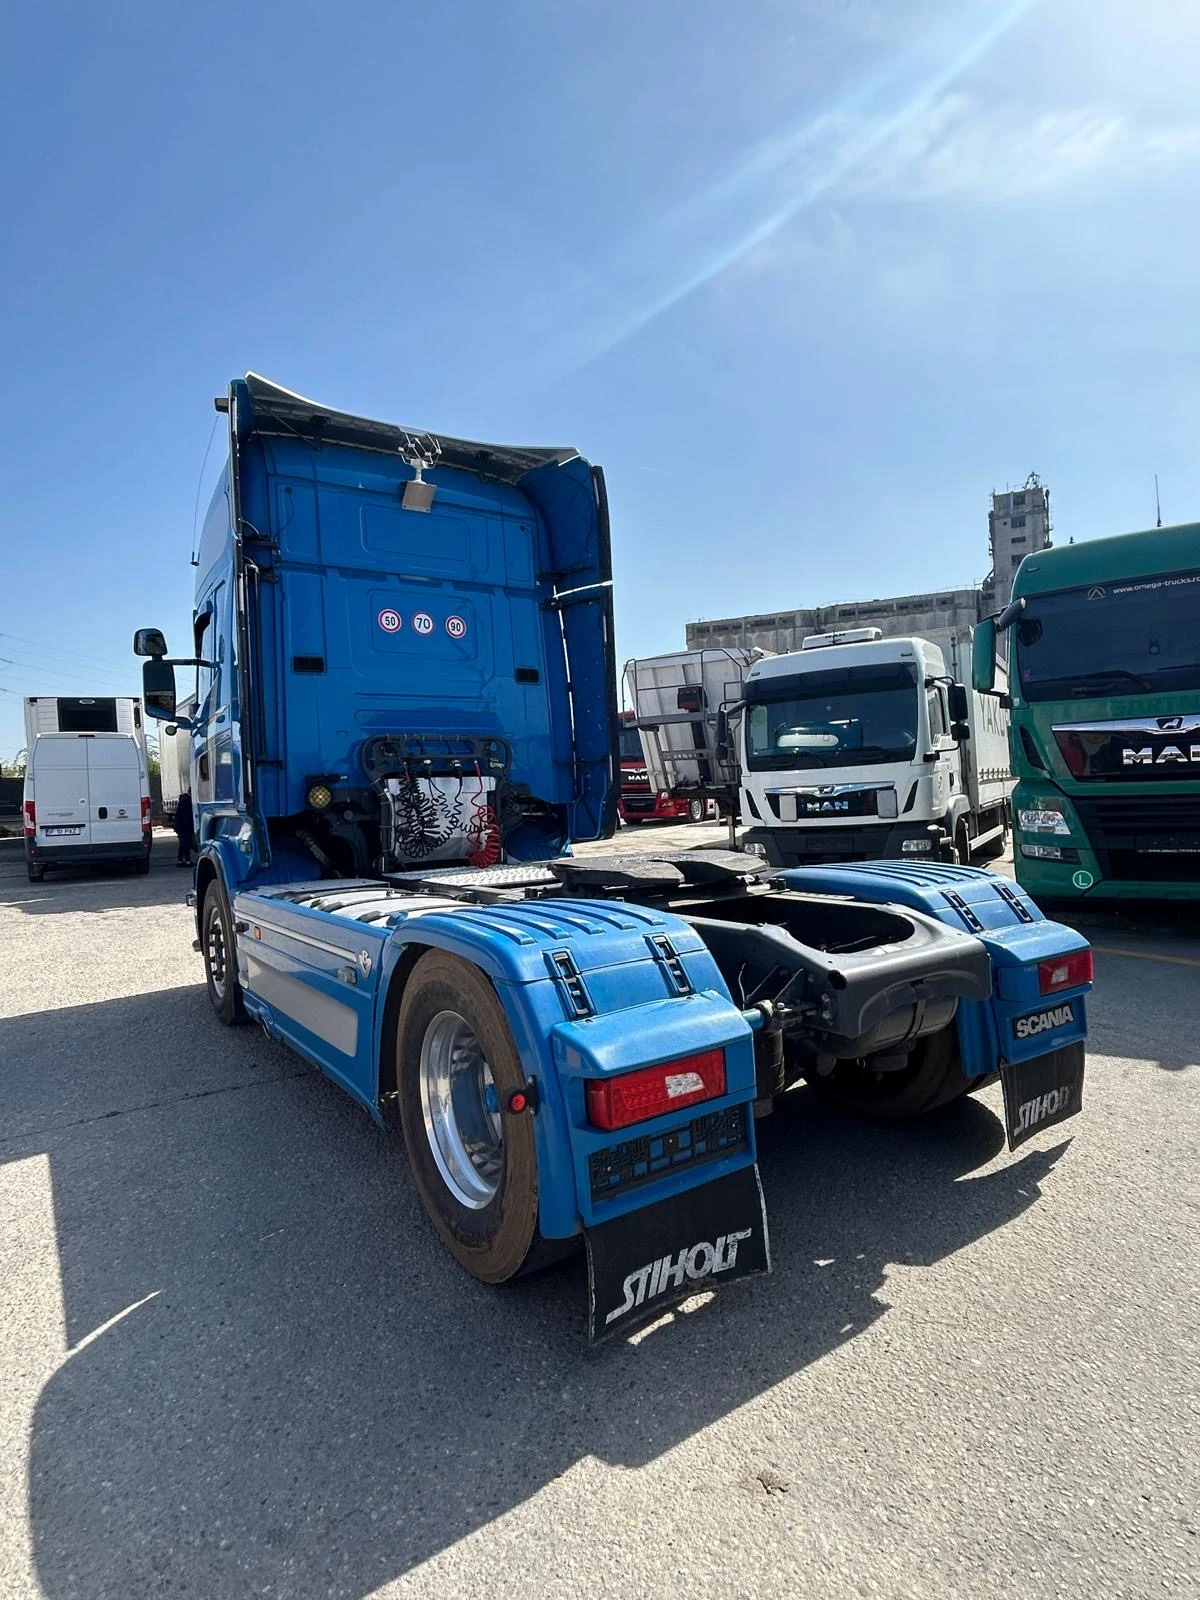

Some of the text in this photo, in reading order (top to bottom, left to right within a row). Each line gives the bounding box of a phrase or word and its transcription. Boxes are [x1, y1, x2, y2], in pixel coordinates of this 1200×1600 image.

[385, 616, 396, 626] 50
[416, 617, 431, 630] 70
[450, 621, 461, 632] 90
[806, 801, 849, 812] MAN
[1078, 874, 1089, 886] L
[1016, 1005, 1074, 1038] SCANIA
[605, 1228, 752, 1324] STIHOLT
